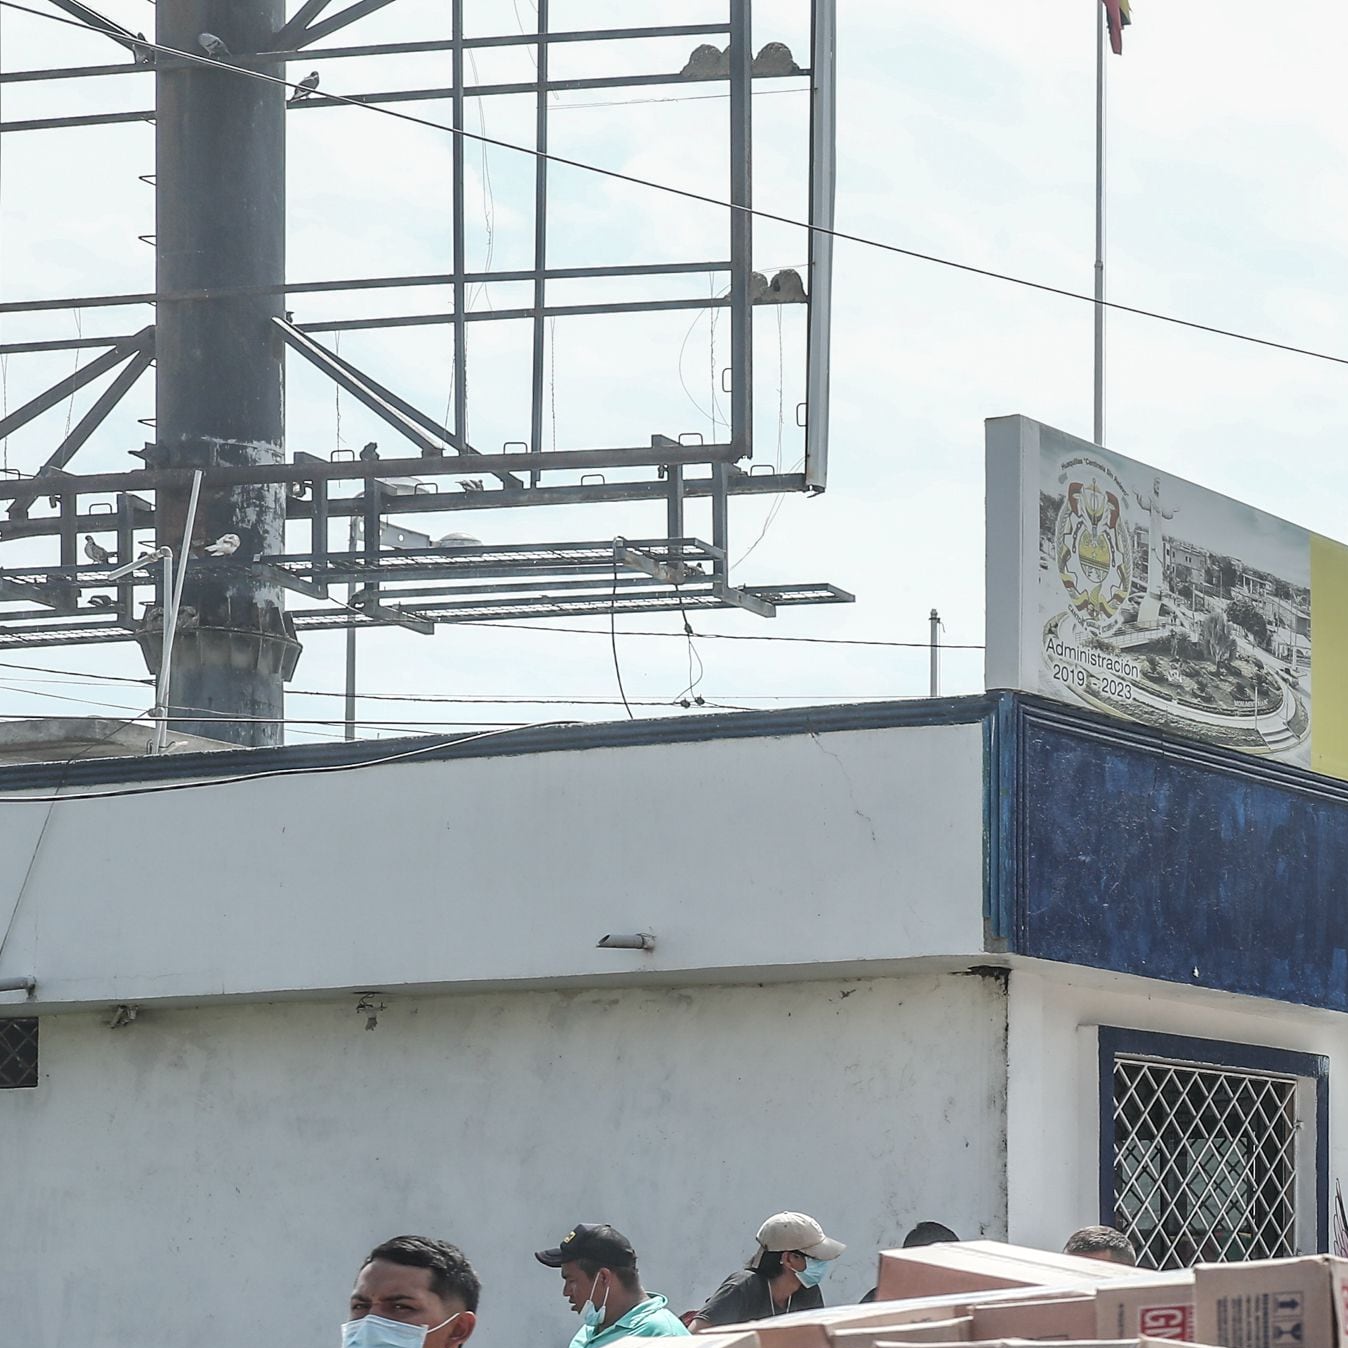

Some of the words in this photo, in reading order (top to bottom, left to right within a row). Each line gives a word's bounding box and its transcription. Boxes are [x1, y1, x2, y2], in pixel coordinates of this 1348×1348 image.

[1046, 637, 1139, 679] Administración
[1053, 664, 1085, 687] 2019
[1101, 677, 1132, 700] 2023
